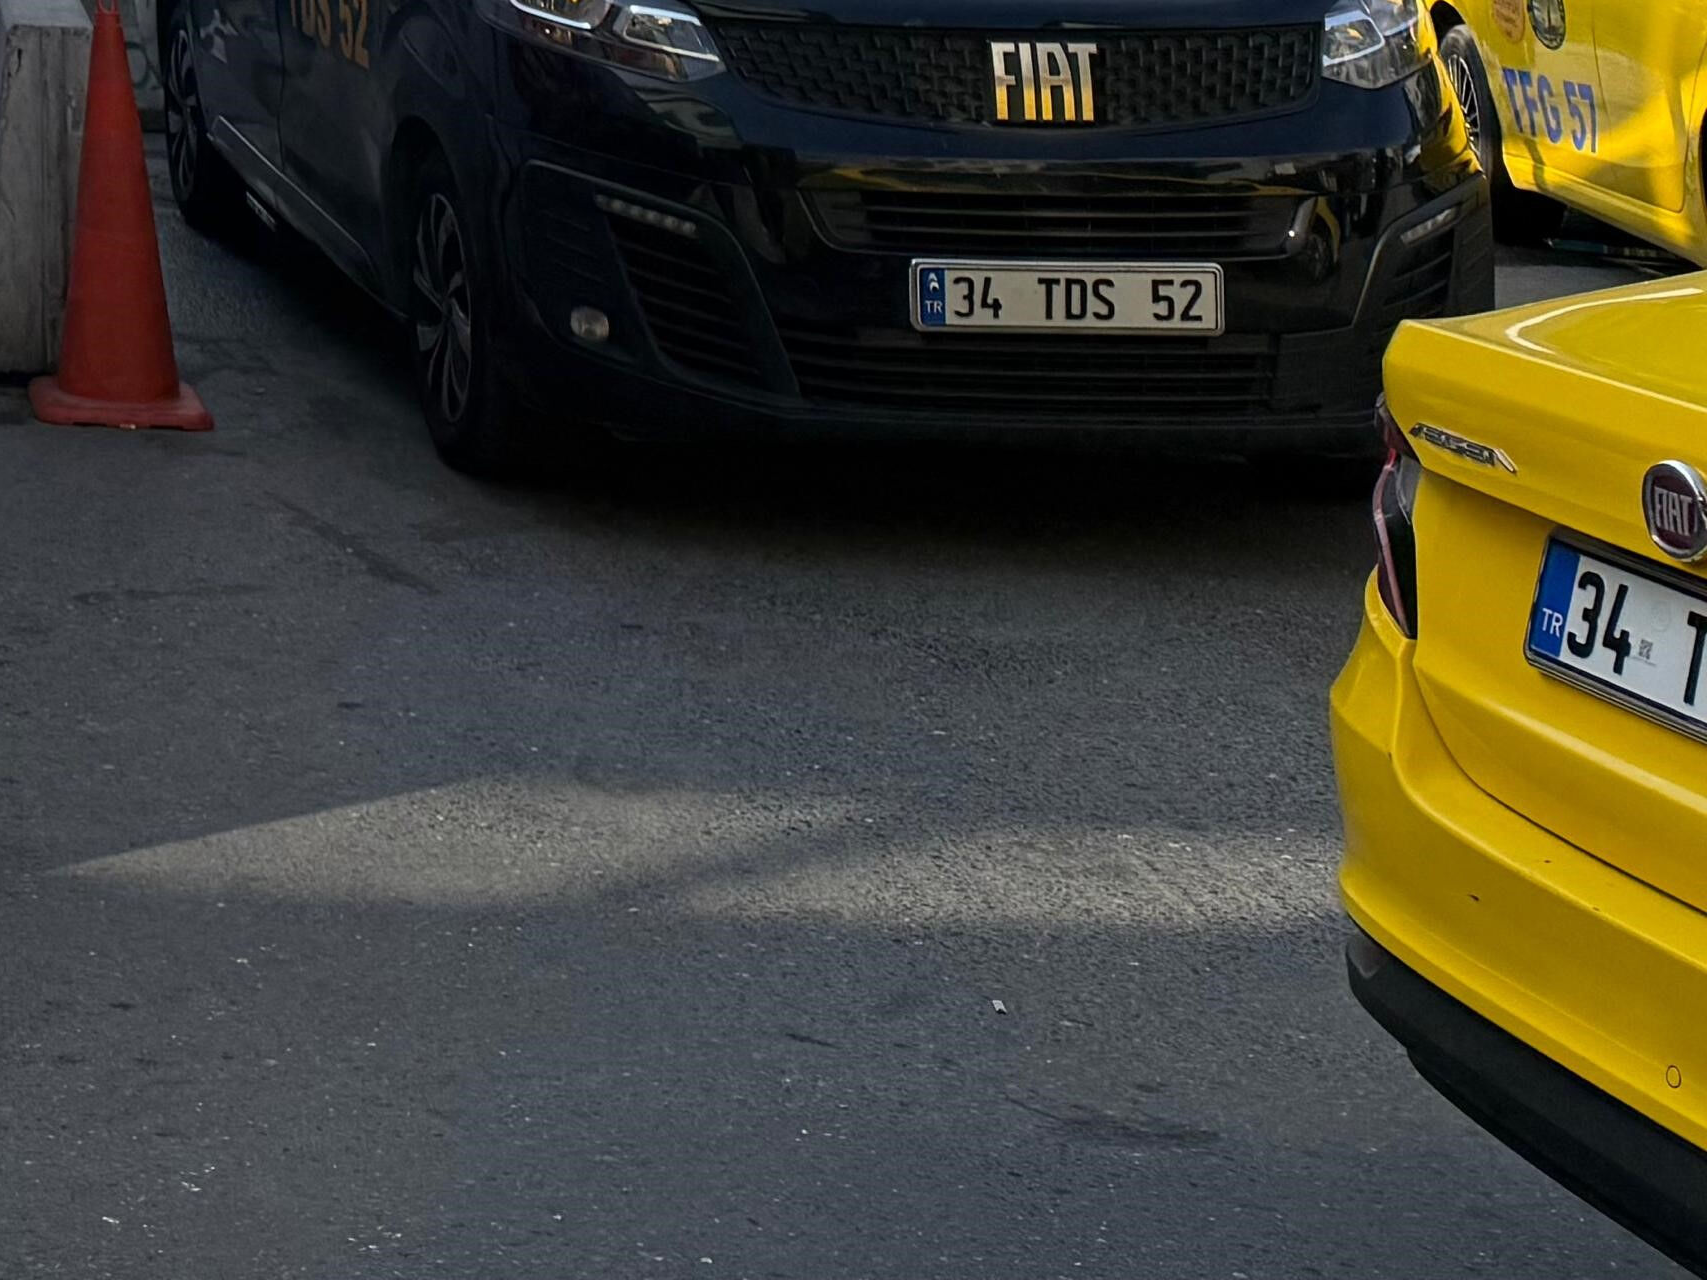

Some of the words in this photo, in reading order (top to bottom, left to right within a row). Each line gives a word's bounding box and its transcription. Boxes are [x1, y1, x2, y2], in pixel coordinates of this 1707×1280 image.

[991, 41, 1098, 123] FIAT
[1502, 67, 1563, 144] TFG
[1563, 80, 1597, 153] 57
[925, 300, 943, 314] TR
[953, 276, 1003, 320] 34
[1037, 277, 1116, 321] TDS
[1151, 279, 1204, 322] 52
[1654, 485, 1693, 536] FIAT
[1541, 607, 1564, 637] TR
[1567, 571, 1632, 676] 34
